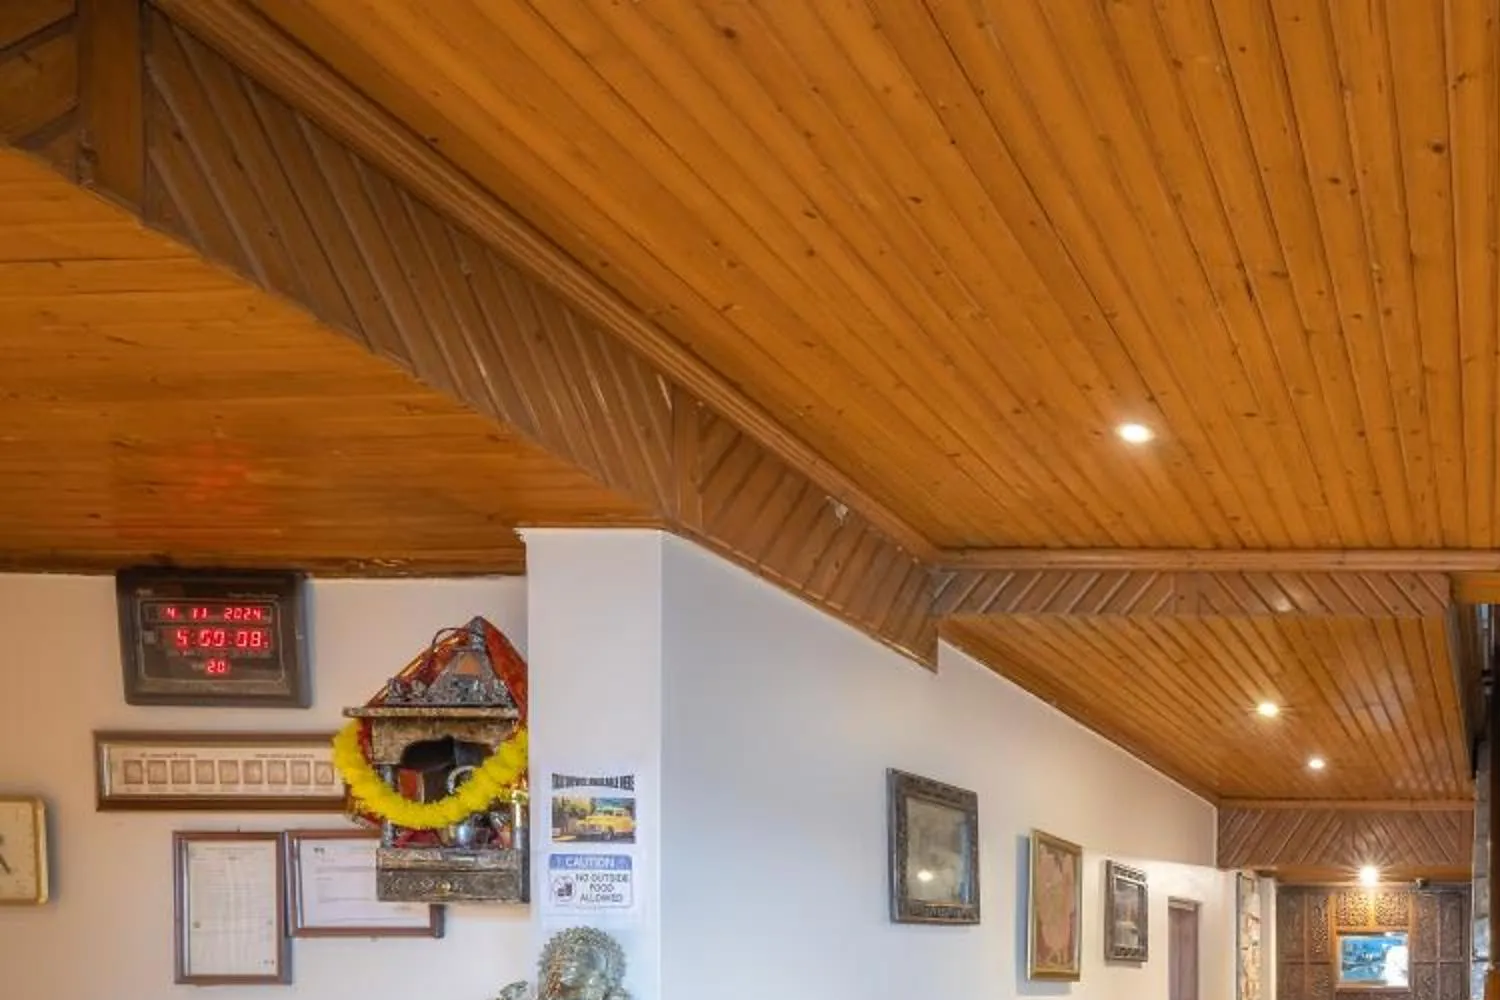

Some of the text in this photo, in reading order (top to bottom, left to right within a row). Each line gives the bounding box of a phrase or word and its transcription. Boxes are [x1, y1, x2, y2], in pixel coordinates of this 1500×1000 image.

[223, 607, 262, 621] 2024
[207, 660, 226, 674] 20
[565, 856, 616, 869] CAUTION
[576, 873, 629, 882] NO OUTSIDE
[589, 883, 615, 892] FOOD
[580, 893, 624, 903] ALLOWED
